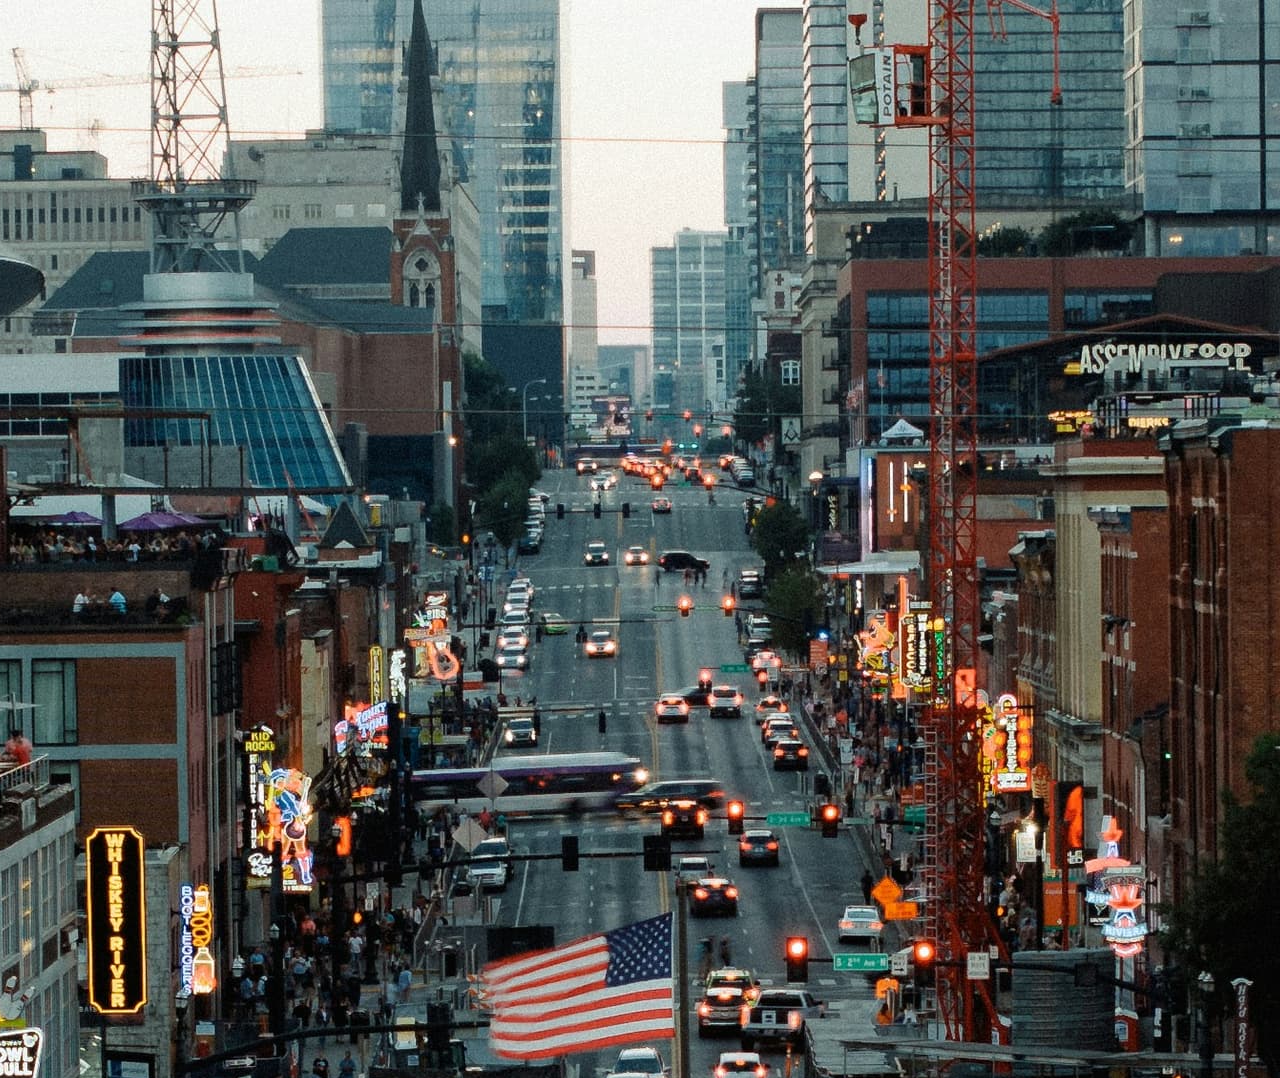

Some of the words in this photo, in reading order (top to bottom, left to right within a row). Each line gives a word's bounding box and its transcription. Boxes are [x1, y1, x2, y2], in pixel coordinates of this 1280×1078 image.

[882, 55, 892, 117] POTAIN
[1183, 343, 1252, 358] FOOD
[251, 732, 270, 742] KID
[105, 834, 125, 932] WHISKEY
[110, 936, 126, 1008] RIVER
[181, 885, 193, 996] BOOTLEGGERS
